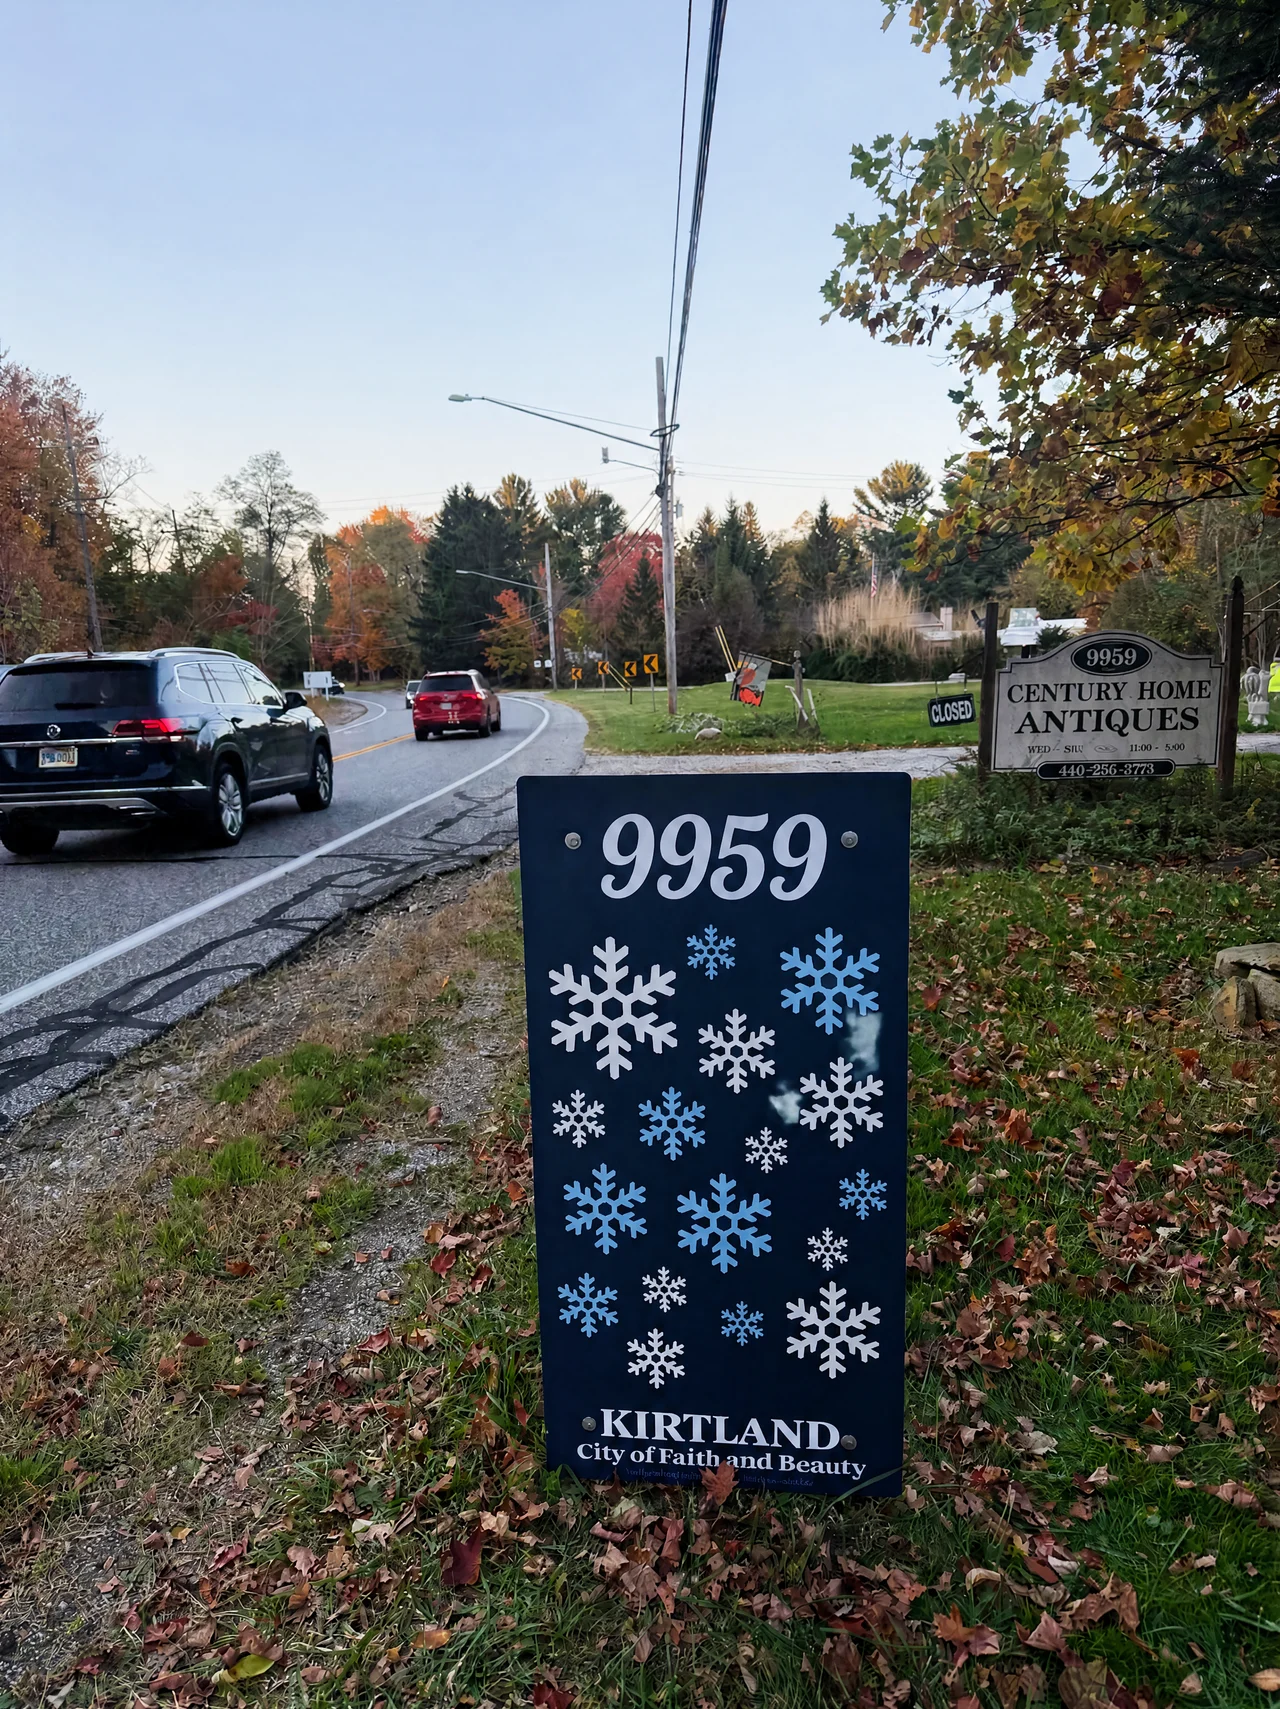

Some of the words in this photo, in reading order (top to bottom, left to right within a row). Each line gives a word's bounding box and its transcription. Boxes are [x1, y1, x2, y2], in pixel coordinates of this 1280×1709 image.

[1086, 647, 1137, 667] 9959
[1007, 682, 1128, 704] CENTURY
[1137, 680, 1212, 700] HOME
[931, 700, 973, 723] CLOSED
[1014, 706, 1199, 737] ANTIQUES
[1028, 745, 1051, 754] WED
[1129, 743, 1152, 752] 11:00
[1058, 763, 1155, 777] 440-256-3773
[600, 812, 828, 902] 9959
[600, 1408, 841, 1450] KIRTLAND
[576, 1443, 625, 1466] City
[630, 1446, 656, 1464] of
[658, 1447, 720, 1468] Faith
[726, 1452, 773, 1471] and
[779, 1455, 867, 1481] Beauty
